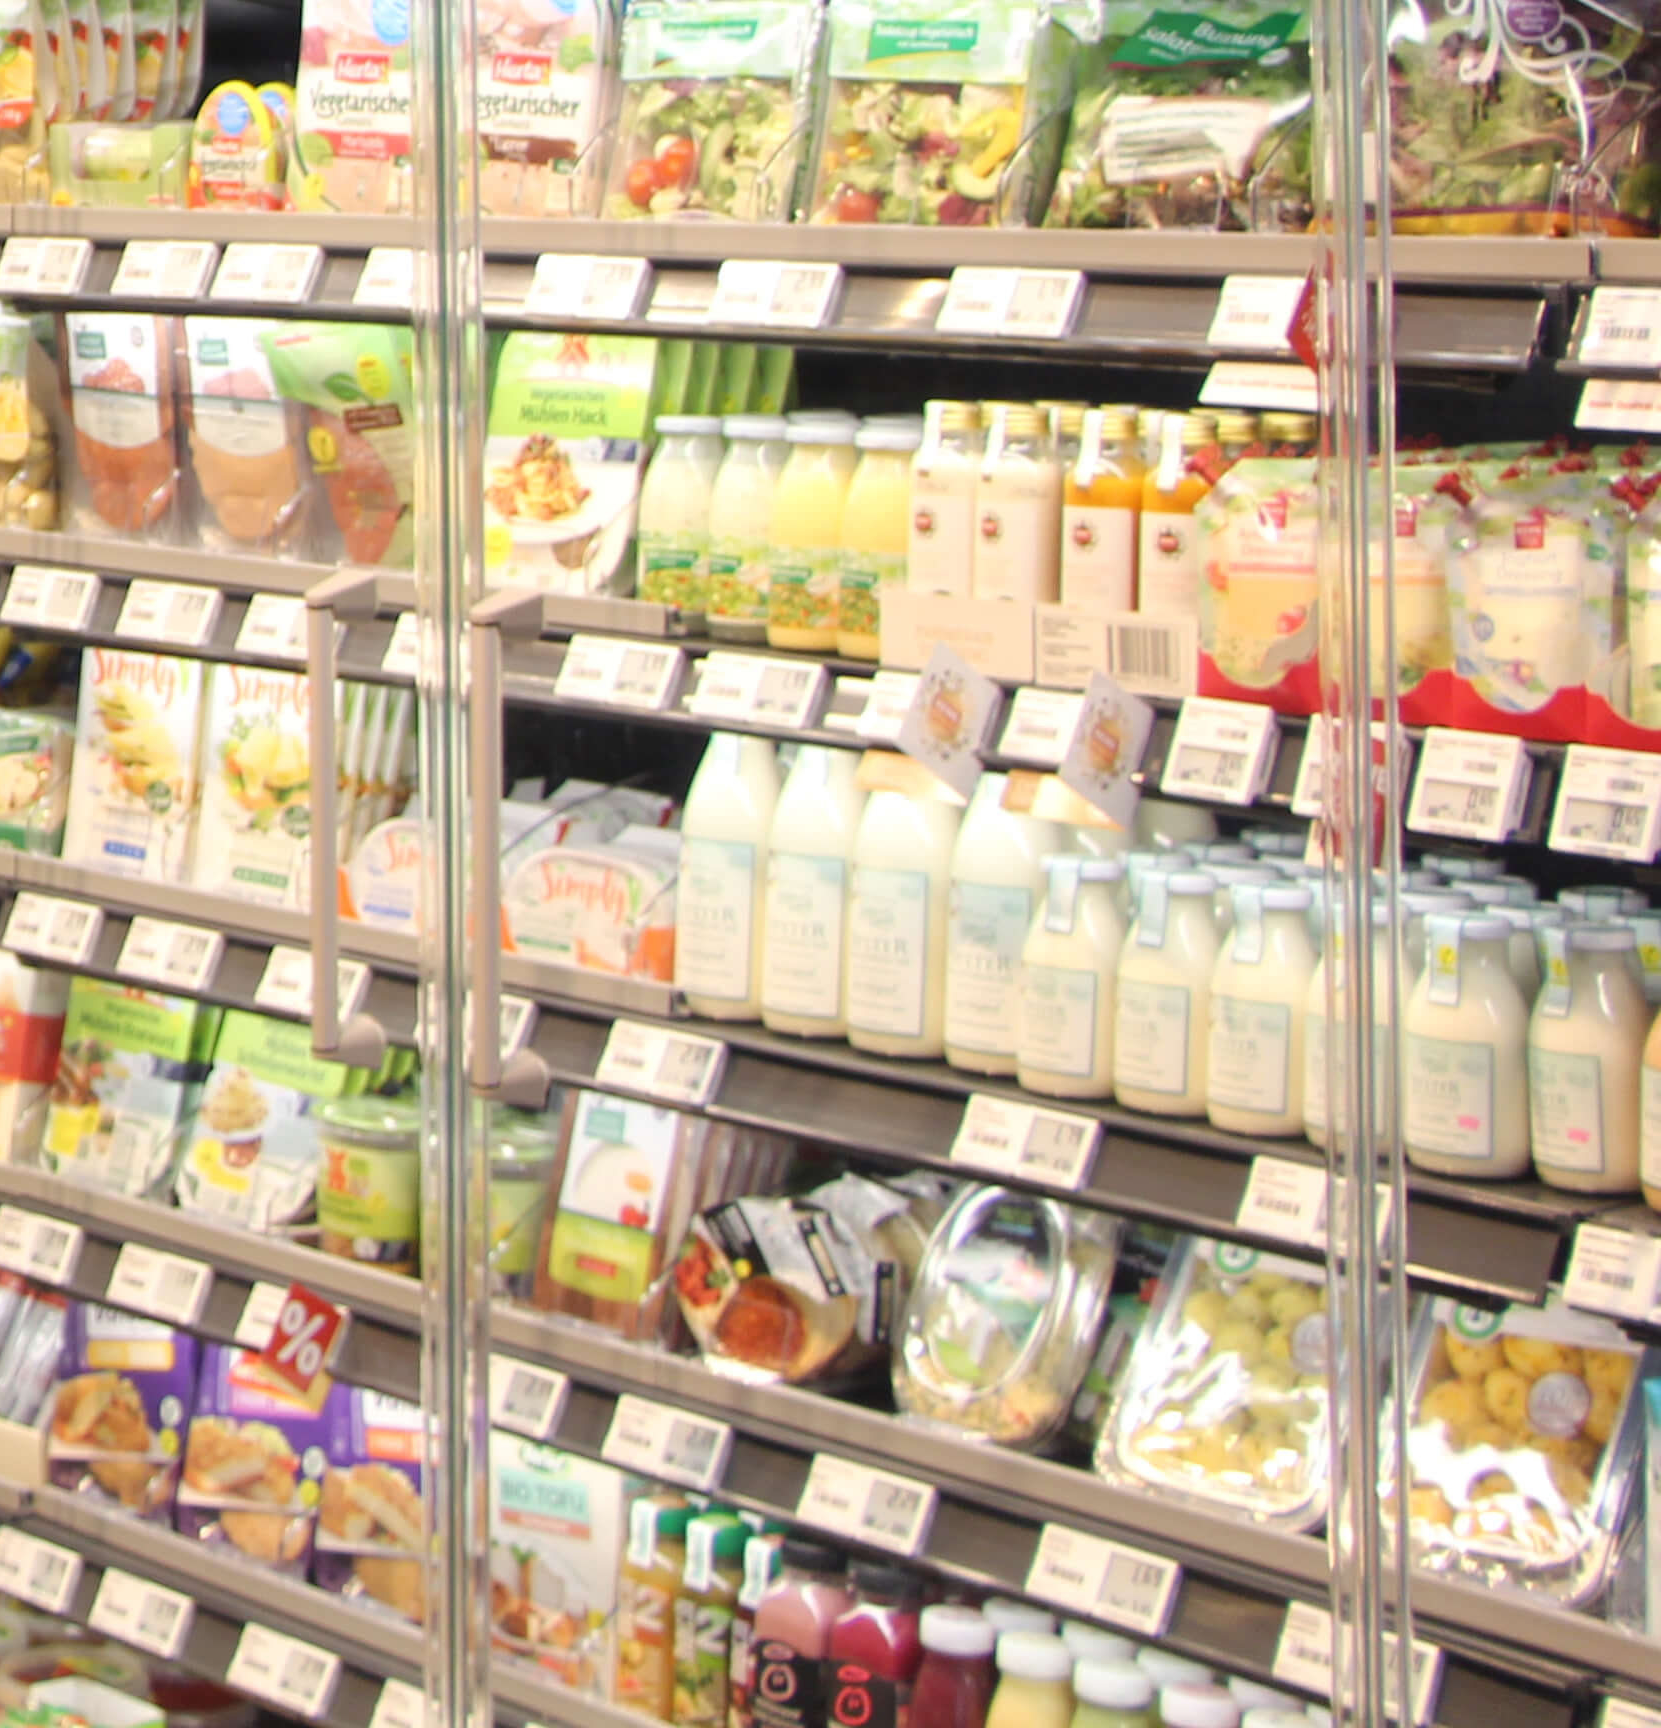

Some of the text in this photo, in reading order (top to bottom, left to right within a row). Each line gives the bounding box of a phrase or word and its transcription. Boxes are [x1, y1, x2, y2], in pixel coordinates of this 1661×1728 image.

[338, 56, 381, 80] Herta
[495, 56, 543, 81] Herta
[311, 81, 409, 118] Vegetarische
[477, 91, 582, 119] egetarischer
[573, 405, 608, 427] Hack
[540, 858, 628, 928] Simply
[277, 1298, 326, 1377] %
